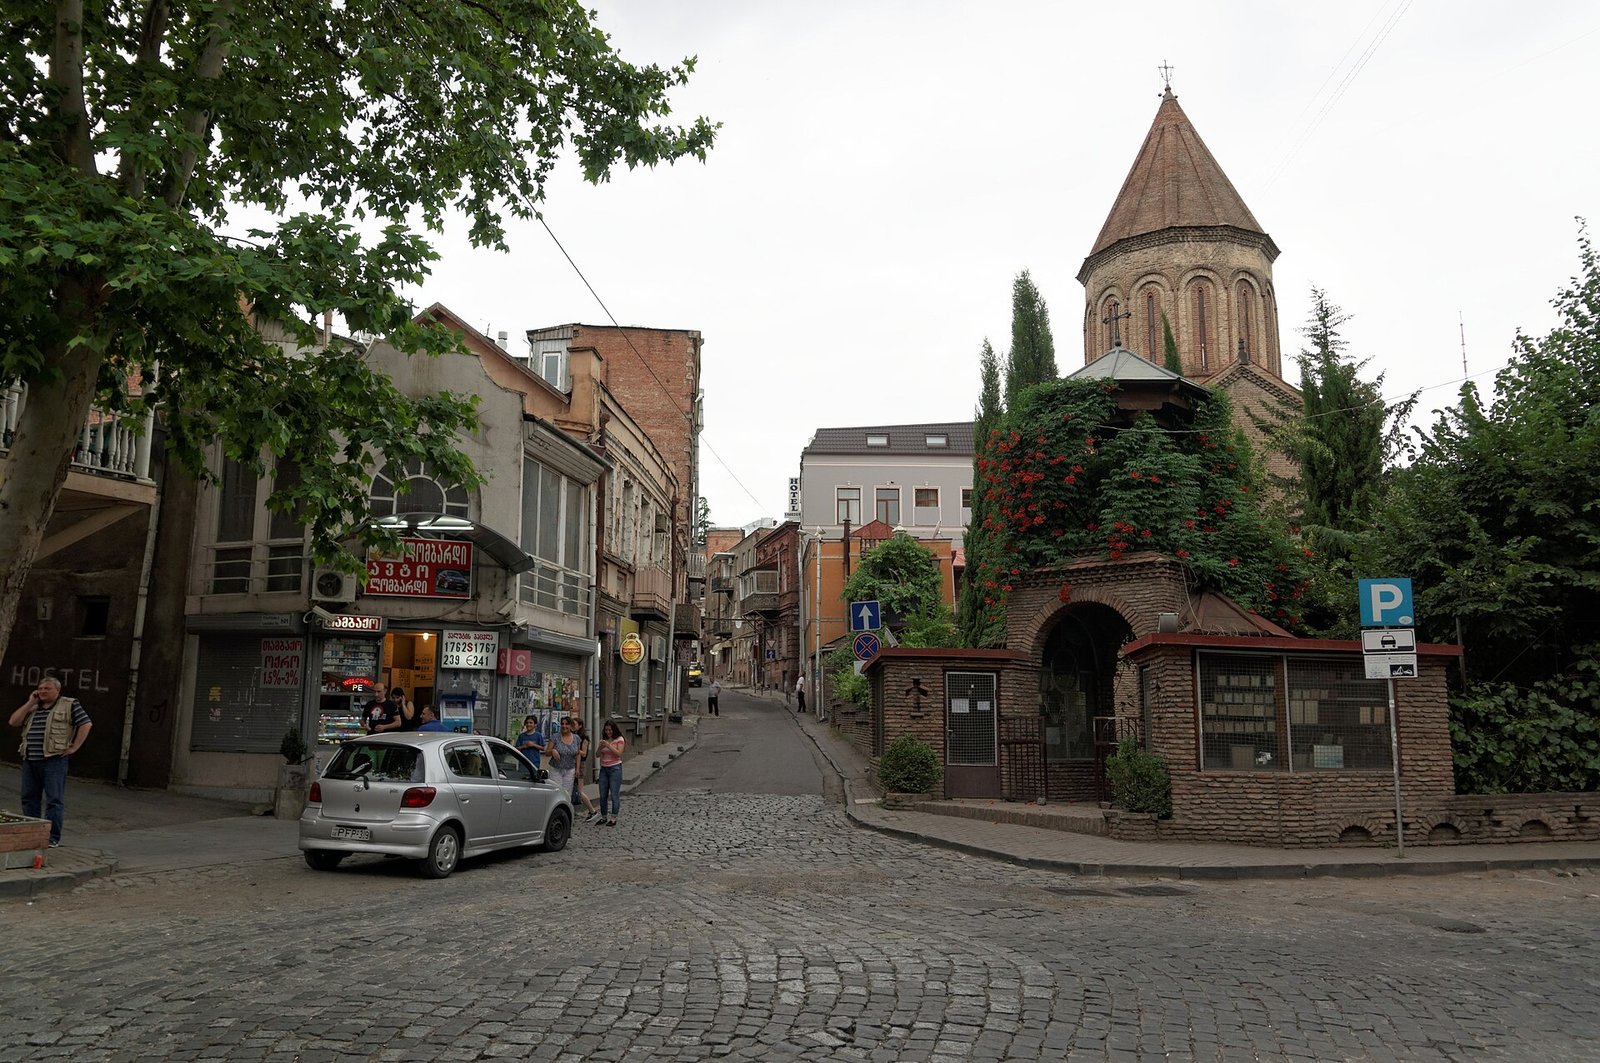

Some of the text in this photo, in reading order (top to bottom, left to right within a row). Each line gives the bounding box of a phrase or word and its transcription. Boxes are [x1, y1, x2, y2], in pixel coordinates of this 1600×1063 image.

[790, 478, 798, 512] HOTEL
[405, 542, 467, 565] ლომბარდი
[371, 562, 429, 578] ავტო
[370, 578, 428, 594] ლომბარდი
[1370, 583, 1404, 623] P
[262, 640, 303, 652] თამბაქო
[264, 655, 300, 669] ოქრო
[443, 654, 460, 666] 239
